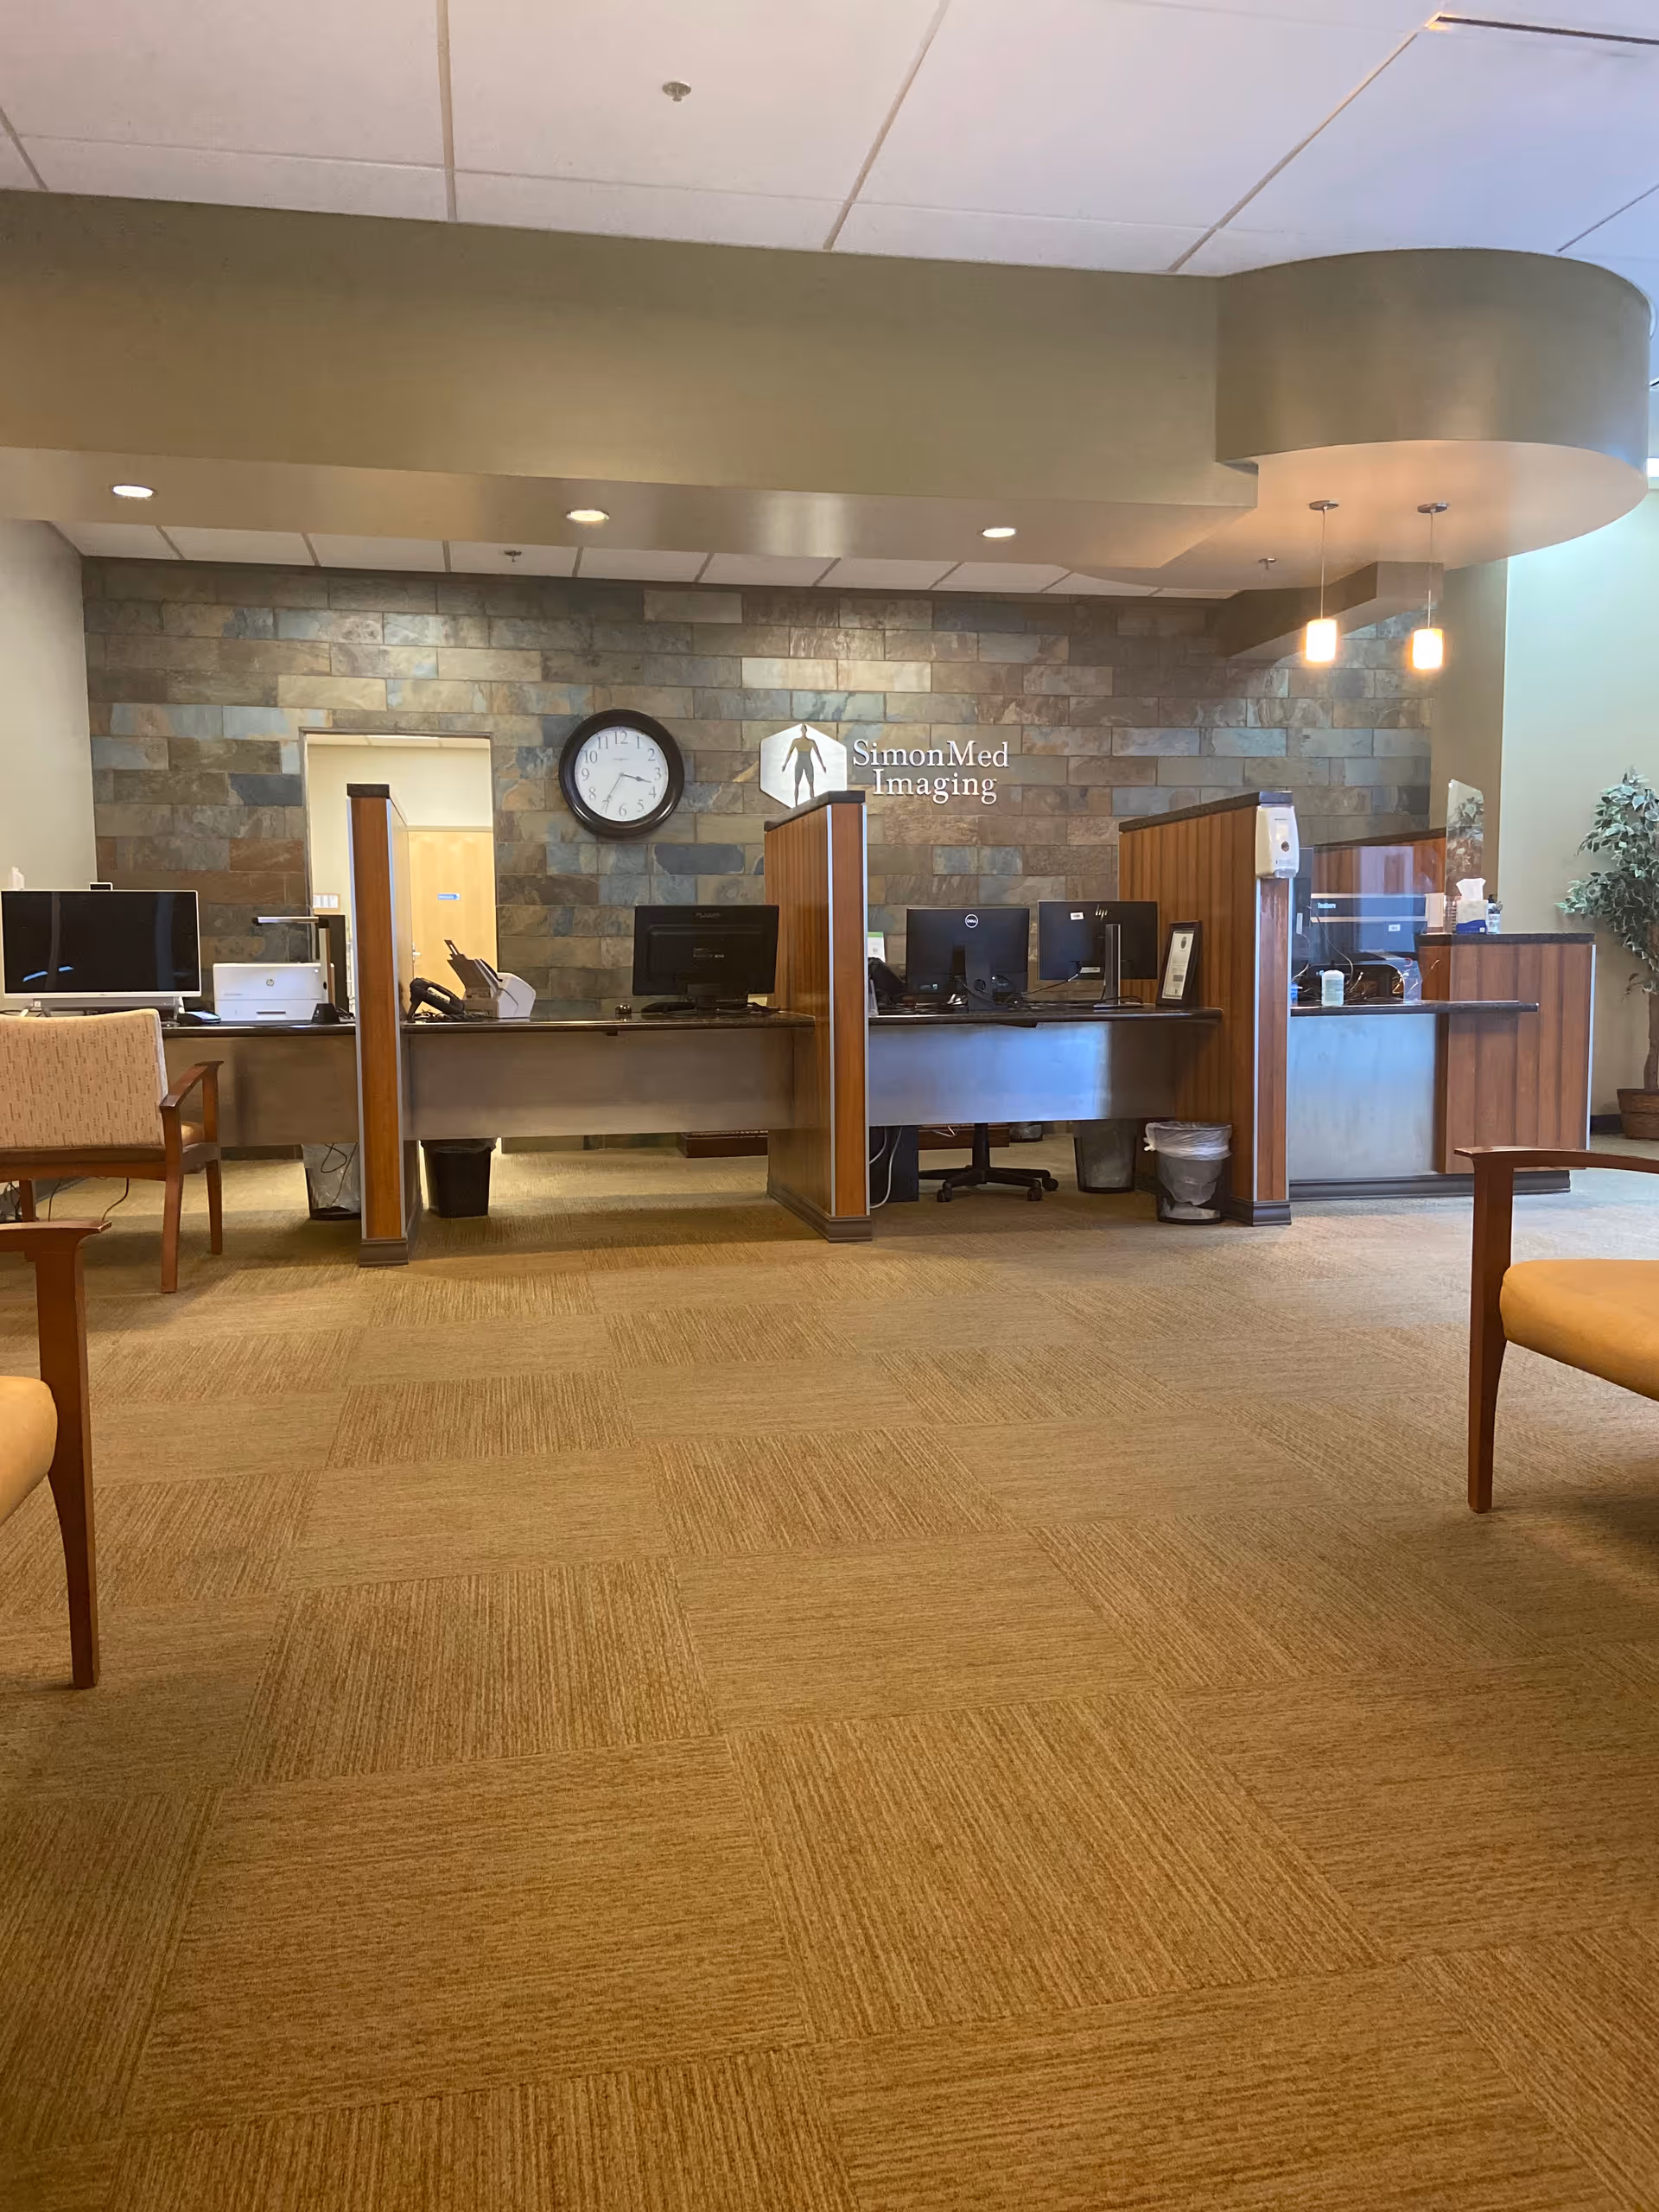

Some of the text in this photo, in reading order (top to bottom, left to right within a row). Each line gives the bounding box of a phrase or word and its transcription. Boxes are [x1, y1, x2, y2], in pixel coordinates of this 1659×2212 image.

[598, 735, 609, 750] 11
[614, 730, 628, 745] 12
[636, 735, 640, 749] 1
[584, 749, 598, 764] 10
[647, 748, 656, 761] 2
[853, 739, 1009, 767] SimonMed
[581, 767, 590, 781] 9
[654, 767, 662, 781] 3
[648, 785, 657, 799] 4
[873, 768, 998, 804] Imaging
[588, 787, 596, 800] 8
[601, 799, 610, 811] 7
[619, 803, 627, 817] 6
[636, 799, 645, 812] 5
[1095, 904, 1108, 921] hp
